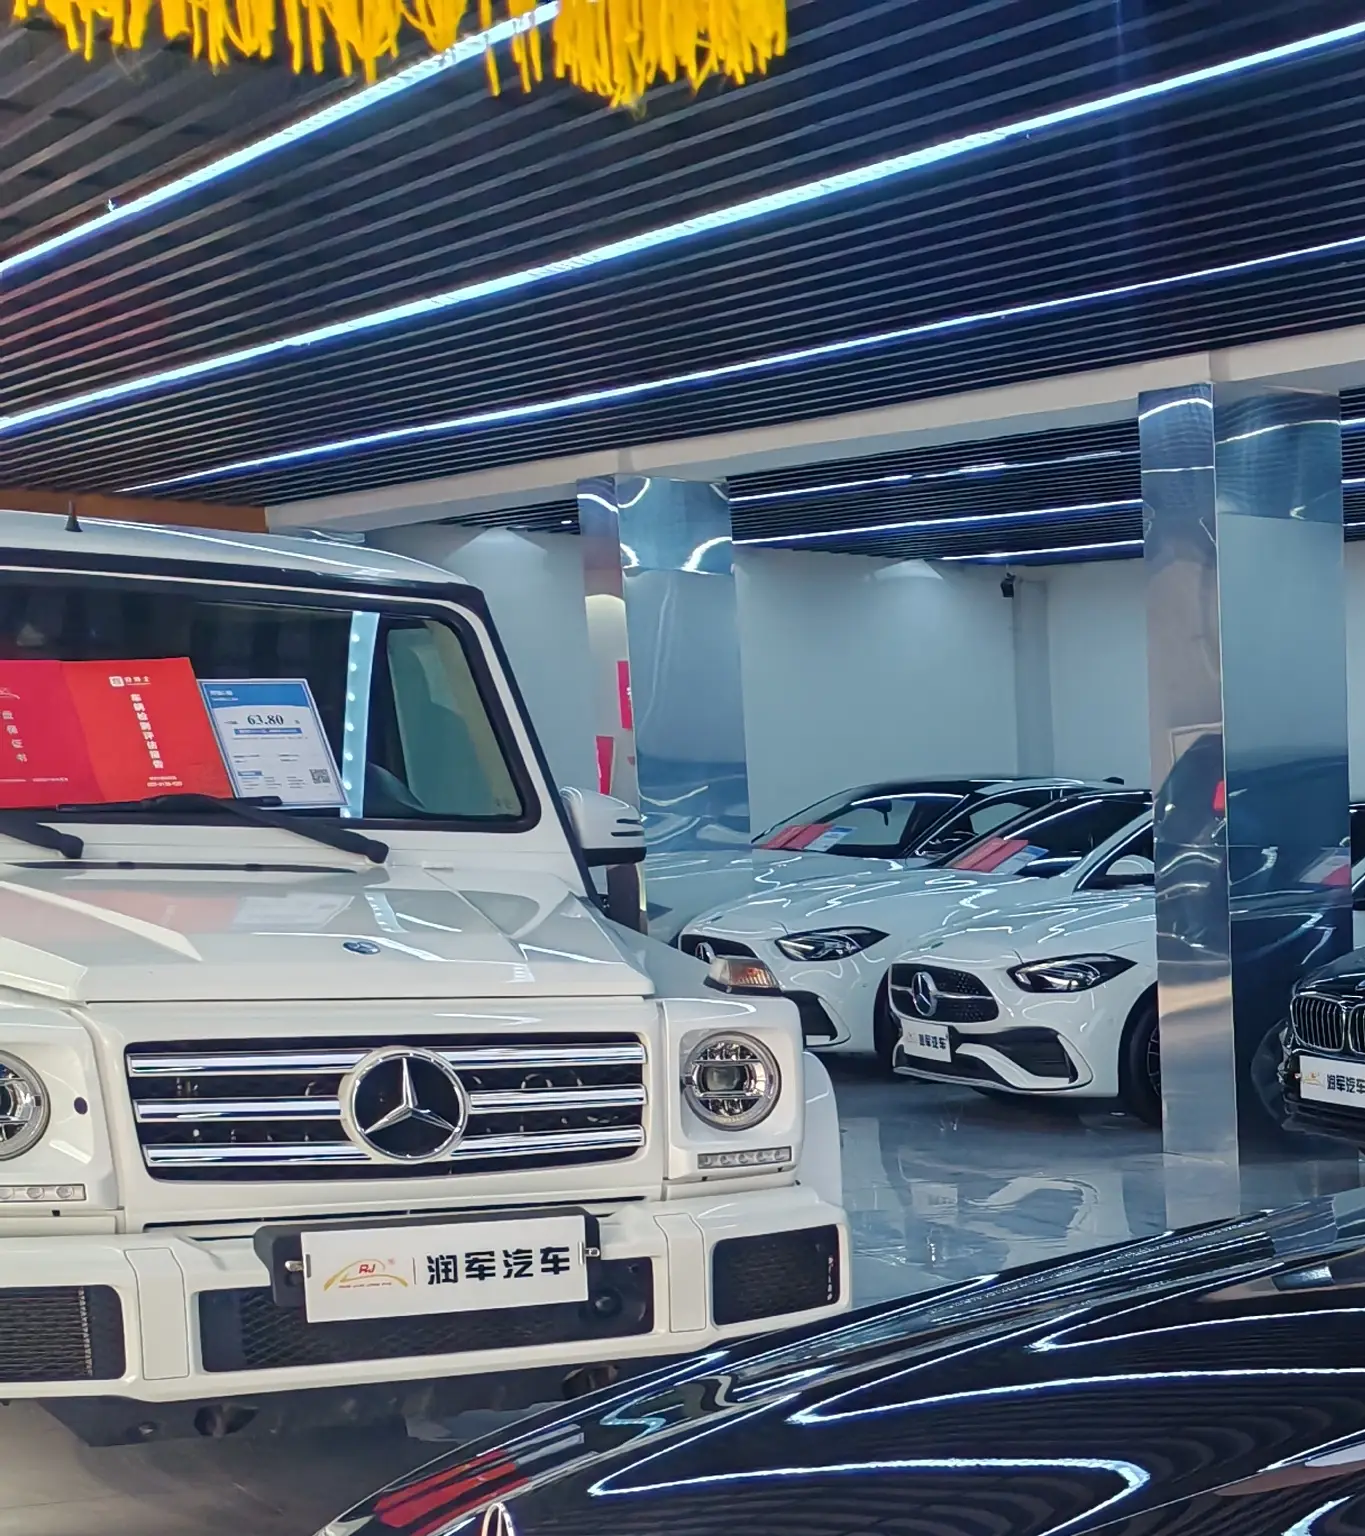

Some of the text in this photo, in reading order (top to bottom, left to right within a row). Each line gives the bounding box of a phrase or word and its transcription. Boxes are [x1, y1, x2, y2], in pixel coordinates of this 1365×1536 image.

[246, 714, 284, 725] 63.80
[426, 1246, 571, 1286] 润军汽车
